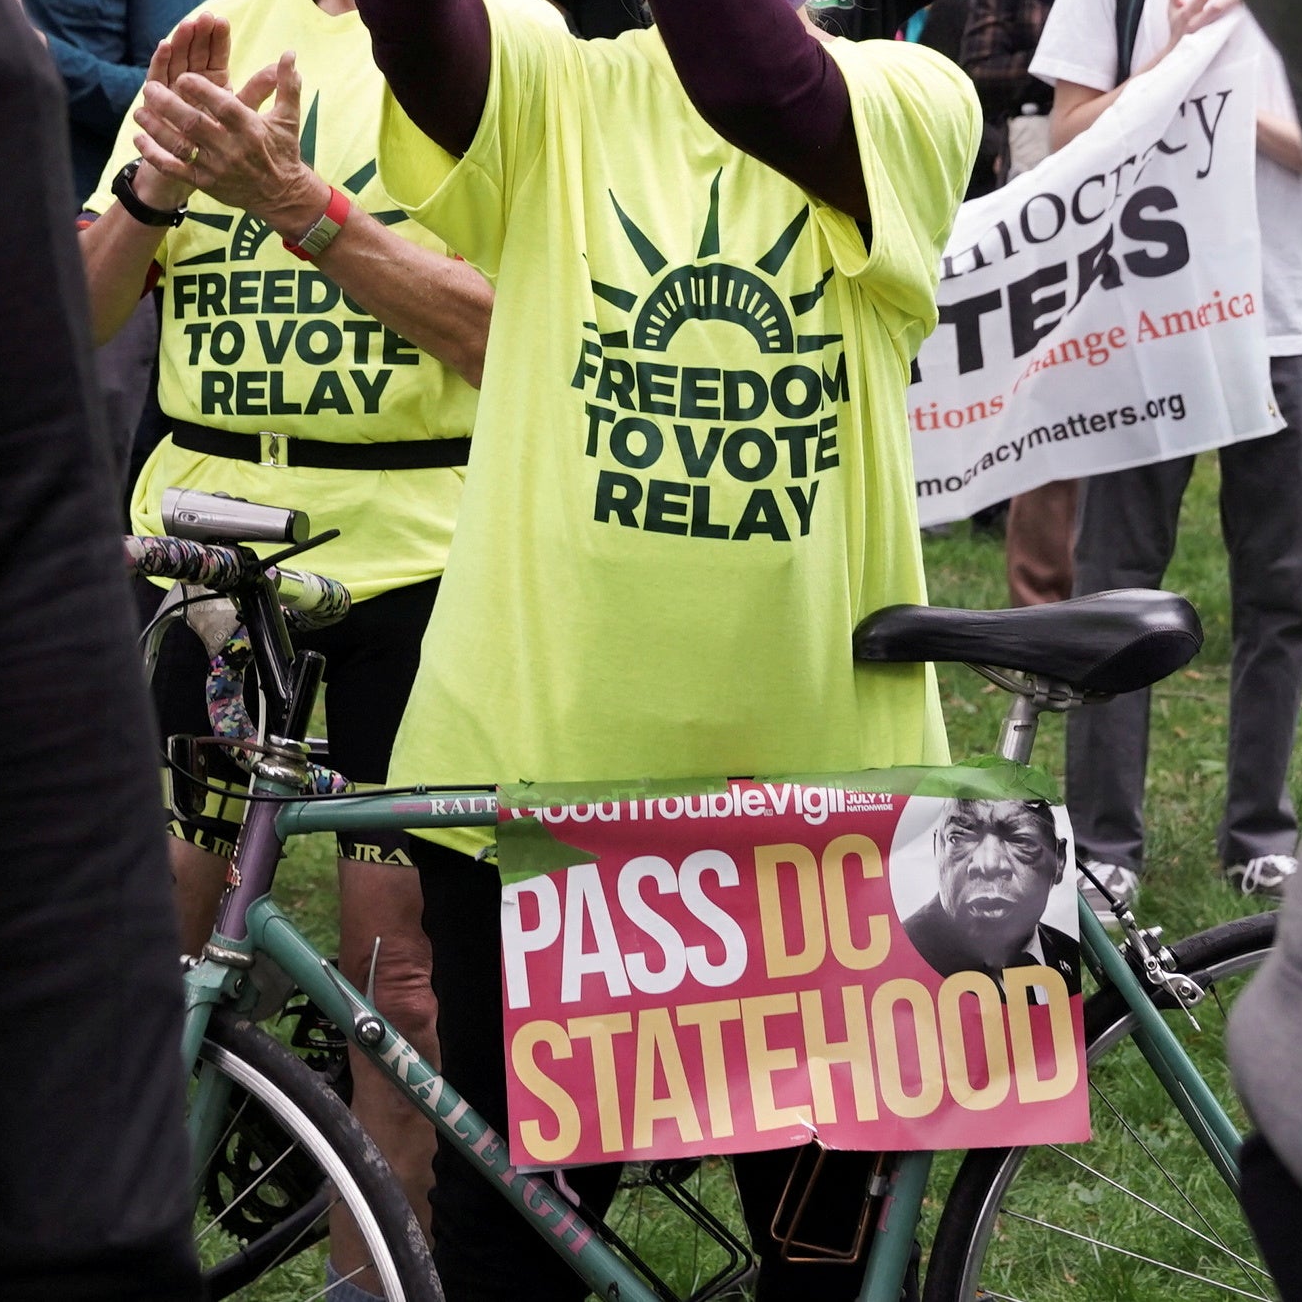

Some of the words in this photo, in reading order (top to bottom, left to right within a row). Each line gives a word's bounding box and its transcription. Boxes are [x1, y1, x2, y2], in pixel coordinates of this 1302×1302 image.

[184, 320, 245, 366] TO
[255, 320, 420, 366] VOTE
[570, 338, 851, 422] FREEDOM
[908, 394, 1006, 434] tions
[1136, 290, 1255, 344] America
[201, 370, 393, 415] RELAY
[585, 401, 664, 470] TO
[673, 414, 840, 482] VOTE
[594, 470, 820, 542] RELAY
[846, 793, 876, 805] JULY
[879, 793, 893, 804] 17
[846, 803, 894, 812] NATIONWIDE
[502, 848, 748, 1009] PASS
[754, 834, 891, 979] DC
[511, 965, 1080, 1162] STATEHOOD
